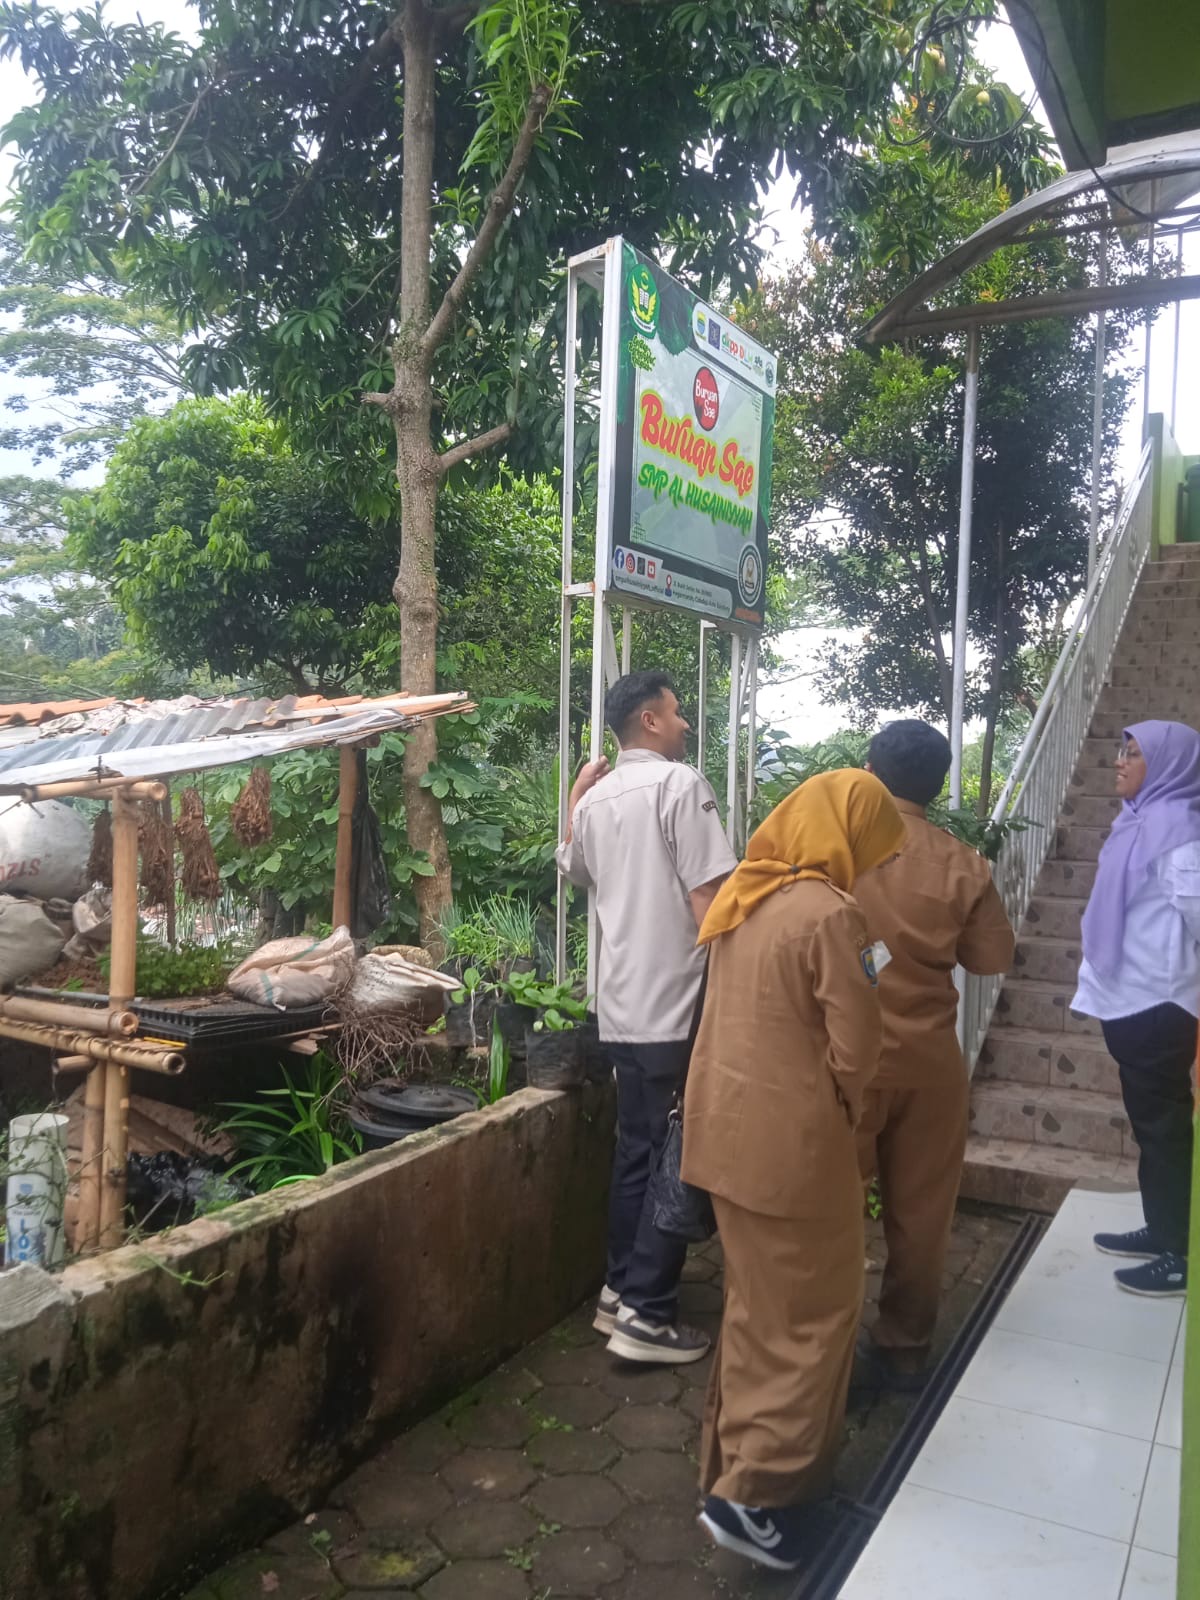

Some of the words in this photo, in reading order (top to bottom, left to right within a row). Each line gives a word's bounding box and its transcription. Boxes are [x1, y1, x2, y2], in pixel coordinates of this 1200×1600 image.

[695, 379, 718, 403] Buruan
[703, 400, 717, 419] Sae
[640, 391, 718, 479] Buruan
[718, 440, 755, 498] Sae
[638, 463, 669, 501] SMP
[668, 475, 684, 509] AL
